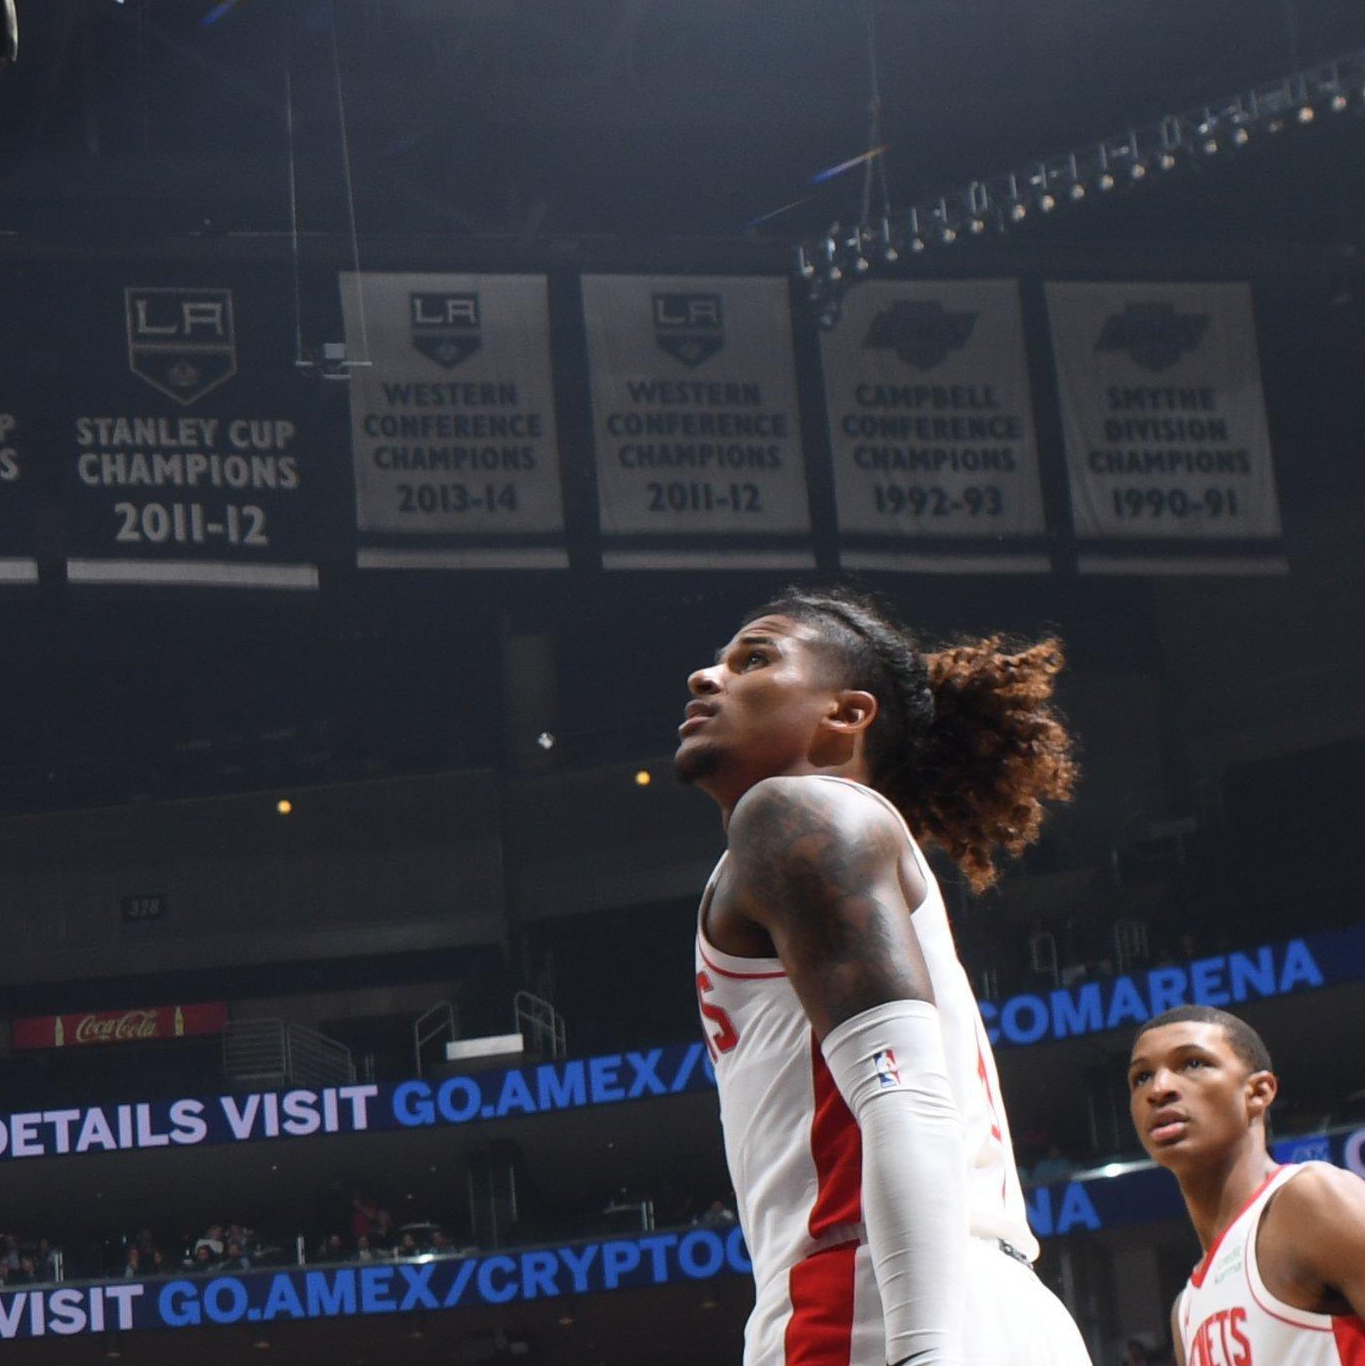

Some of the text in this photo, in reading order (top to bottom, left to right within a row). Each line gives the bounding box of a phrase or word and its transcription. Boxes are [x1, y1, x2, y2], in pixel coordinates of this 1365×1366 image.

[137, 300, 222, 334] LA
[413, 297, 477, 325] LA
[383, 382, 517, 407] WESTERN
[627, 381, 761, 406] WESTERN
[856, 385, 1000, 409] CAMPBELL
[1107, 386, 1215, 410] SMYTHE
[76, 417, 295, 449] STANLEY CUP
[364, 413, 541, 438] CONFERENCE
[607, 413, 787, 437] CONFERENCE
[842, 415, 1022, 441] CONFERENCE
[1104, 418, 1228, 442] DIVISION
[374, 446, 535, 470] CHAMPIONS
[619, 444, 781, 469] CHAMPIONS
[853, 448, 1016, 473] CHAMPIONS
[1089, 450, 1251, 474] CHAMPIONS
[78, 453, 299, 490] CHAMPIONS
[398, 483, 518, 513] 2013-14
[647, 482, 763, 513] 2011-12
[873, 483, 1004, 516] 1992-93
[1112, 488, 1238, 517] 1990-91
[114, 502, 268, 545] 2011-12
[220, 1085, 378, 1140] VISIT
[392, 1041, 719, 1128] GO.AMEX/
